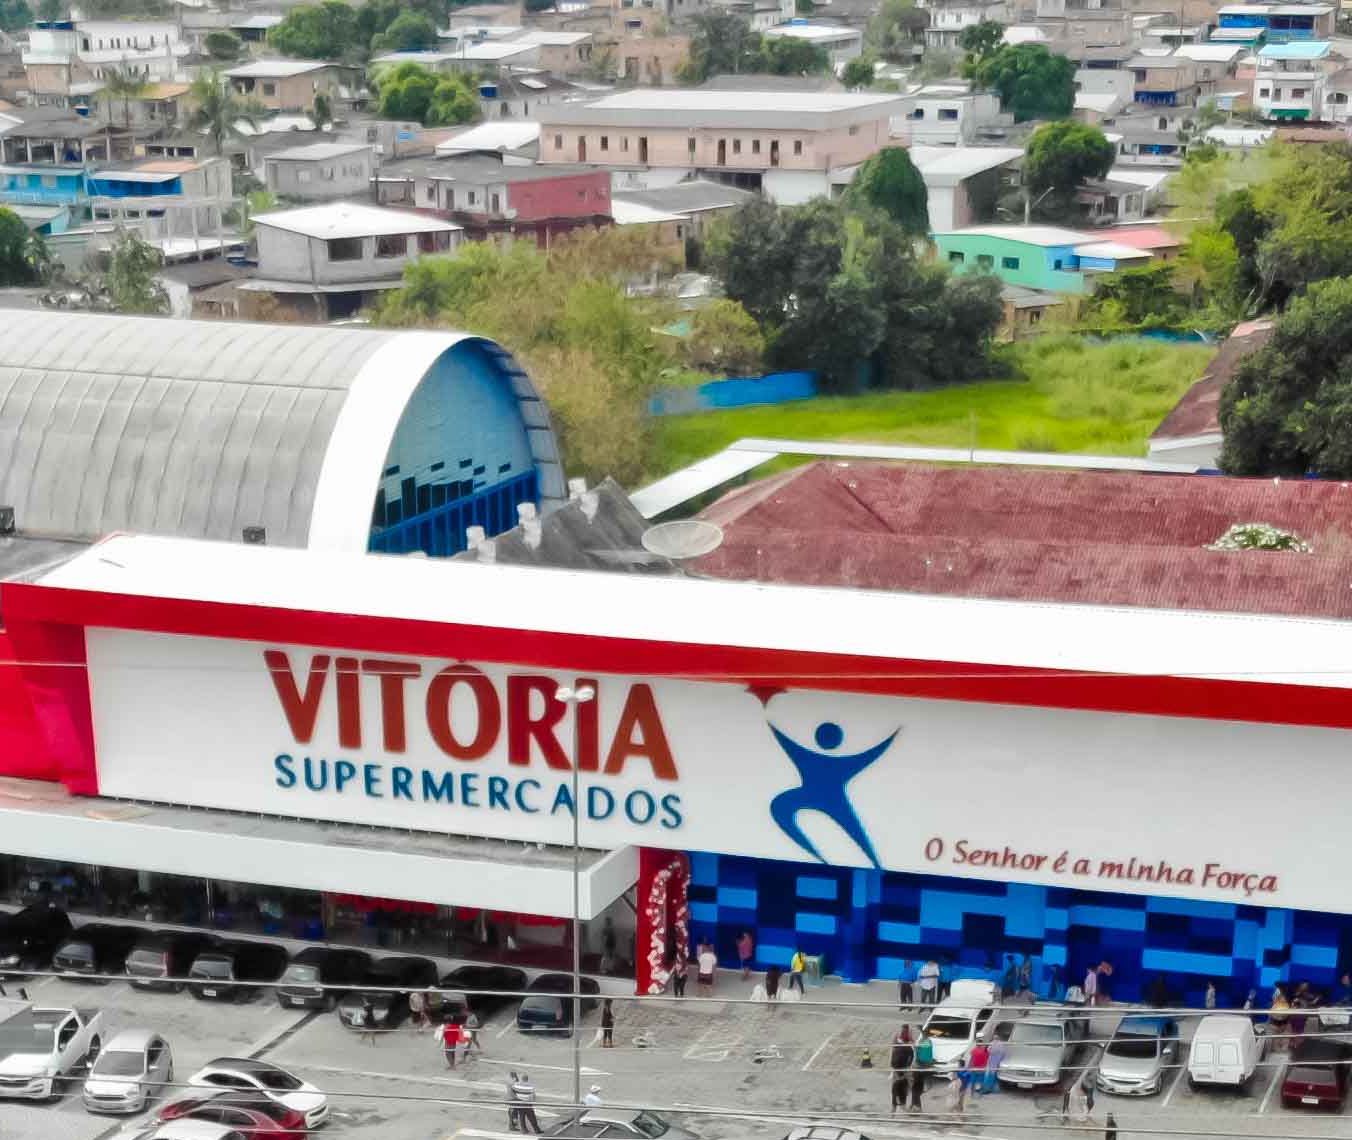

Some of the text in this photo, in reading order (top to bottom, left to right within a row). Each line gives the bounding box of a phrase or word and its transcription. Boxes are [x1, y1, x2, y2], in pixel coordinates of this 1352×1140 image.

[274, 754, 683, 829] SUPERMERCADOS
[924, 837, 1278, 895] O Senhor é a minha Força
